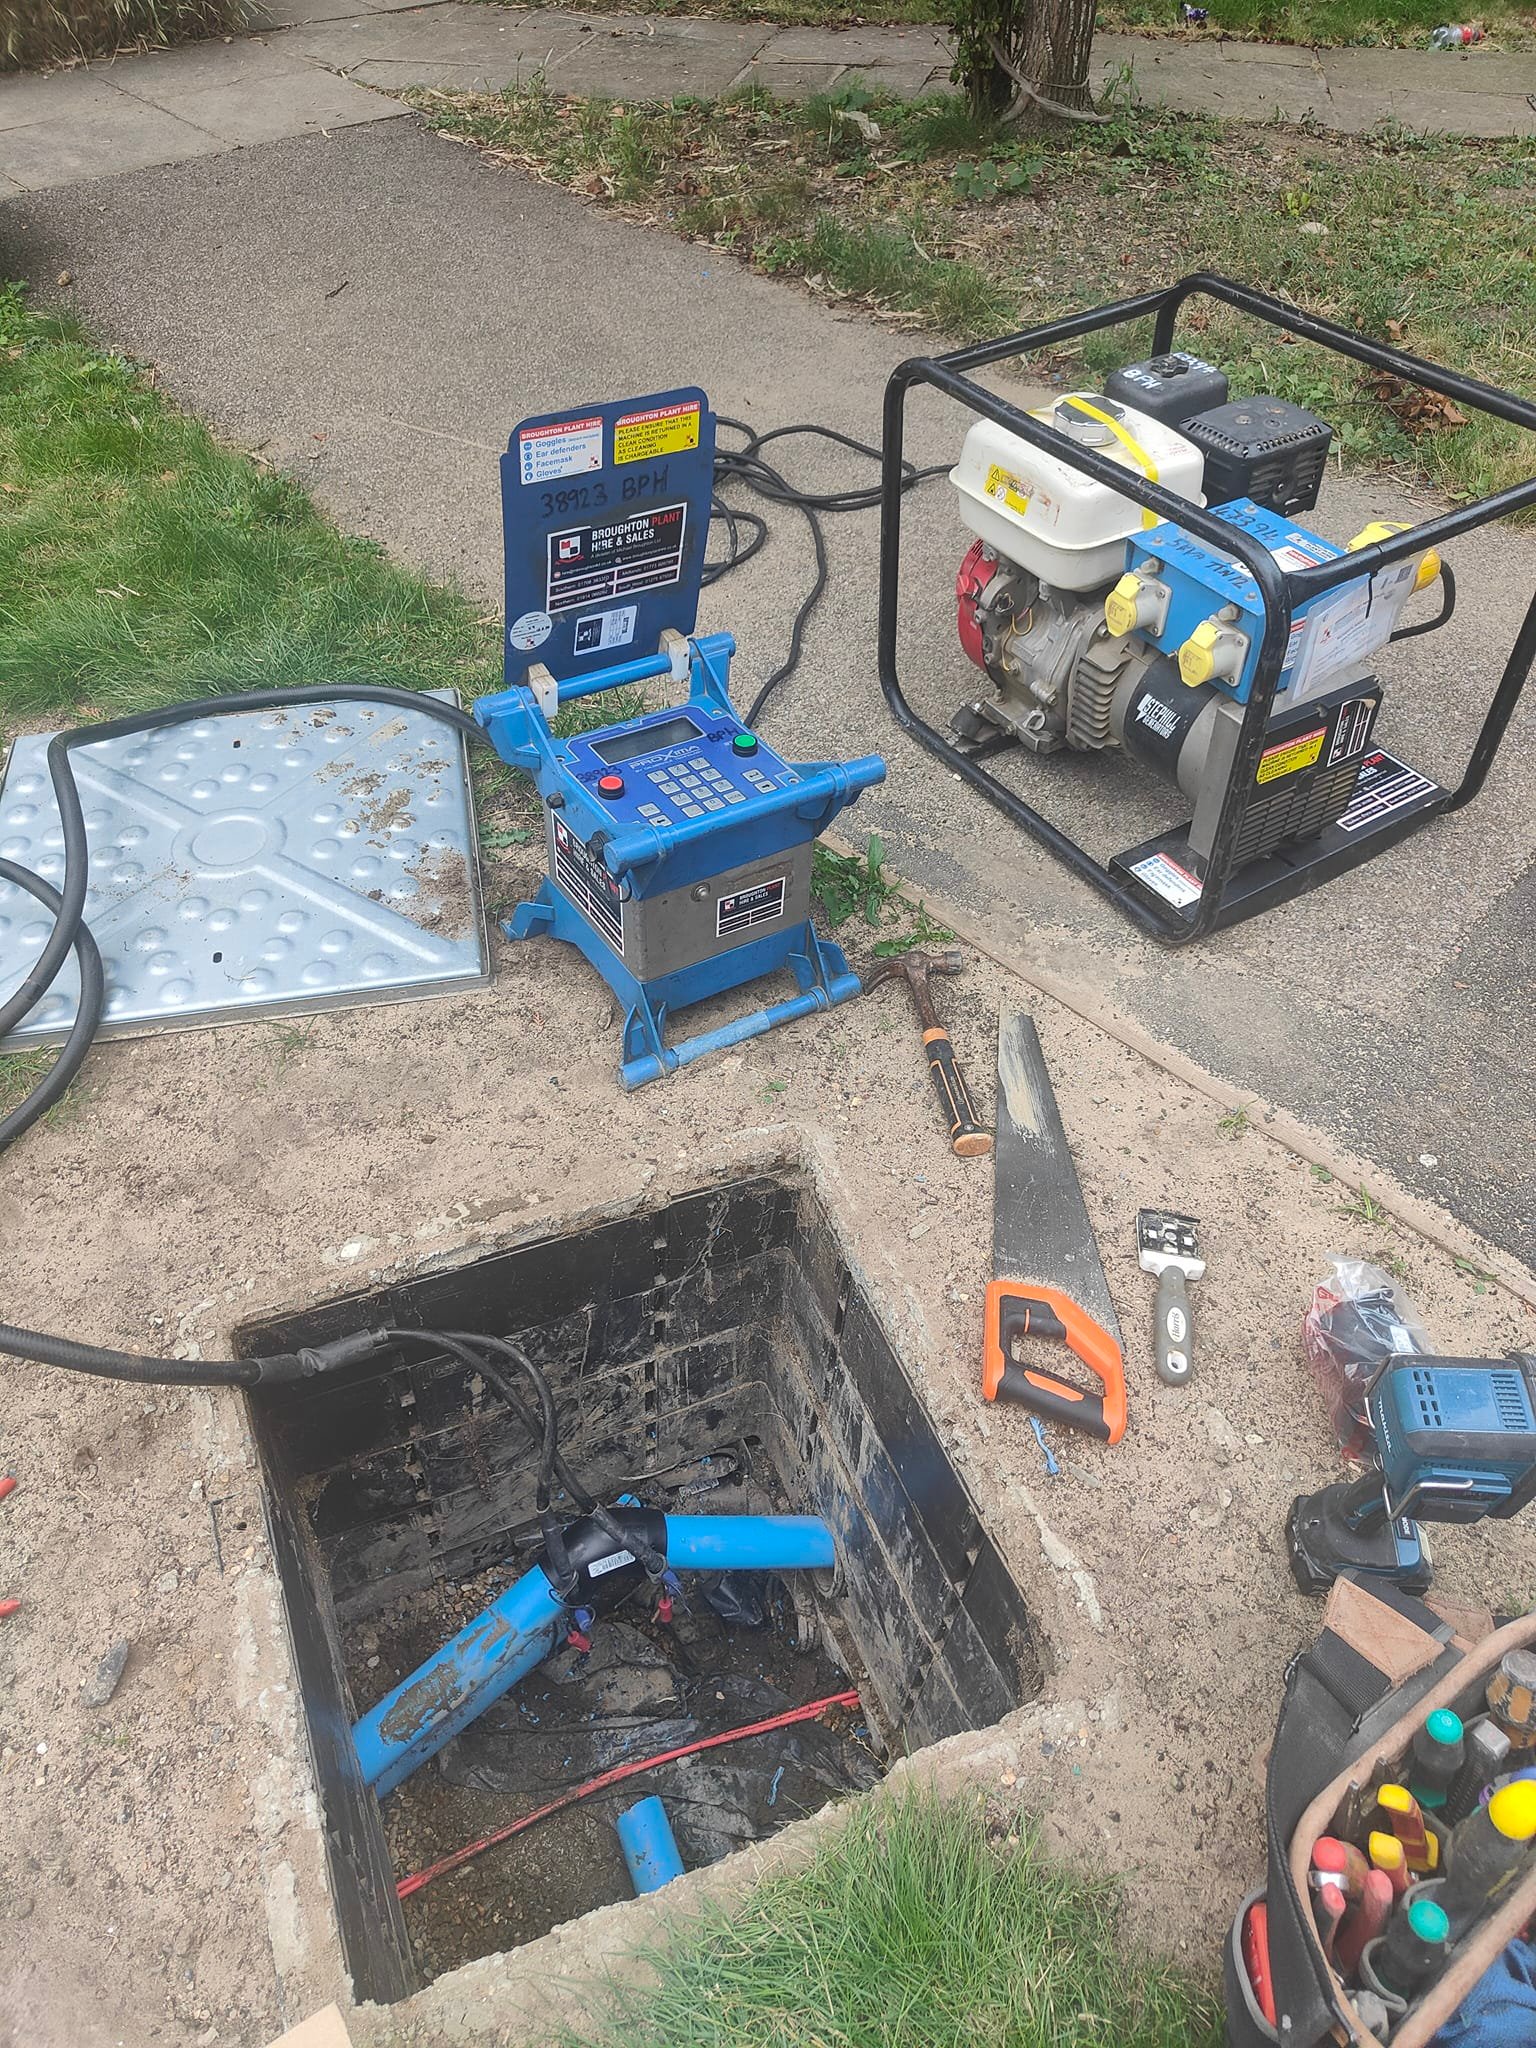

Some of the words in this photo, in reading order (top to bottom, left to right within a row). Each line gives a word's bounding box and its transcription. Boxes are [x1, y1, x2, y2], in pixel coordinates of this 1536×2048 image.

[1122, 369, 1162, 389] BPH
[660, 408, 682, 418] PLANT
[682, 404, 698, 413] HIRE
[521, 427, 563, 440] BROUGHTON
[563, 422, 585, 432] PLANT
[585, 420, 602, 429] HIRE
[618, 426, 640, 435] PLEASE
[641, 421, 664, 431] ENSURE
[665, 418, 679, 426] THAT
[680, 415, 692, 423] THIS
[618, 432, 644, 441] MACHINE
[651, 424, 681, 435] RETURNED
[535, 437, 567, 448] Goggles
[618, 439, 637, 448] CLEAN
[638, 434, 668, 444] CONDITION
[627, 443, 657, 453] CLEANING
[535, 450, 549, 459] Ear
[550, 443, 587, 456] defenders
[536, 455, 574, 468] Facemask
[536, 468, 562, 478] Gloves
[540, 483, 607, 518] 38923
[623, 465, 669, 500] BPH
[592, 518, 650, 541] BROUGHTON
[651, 511, 681, 527] PLANT
[616, 536, 623, 546] &
[626, 528, 655, 544] SALES
[1143, 698, 1181, 731] STEPHILL
